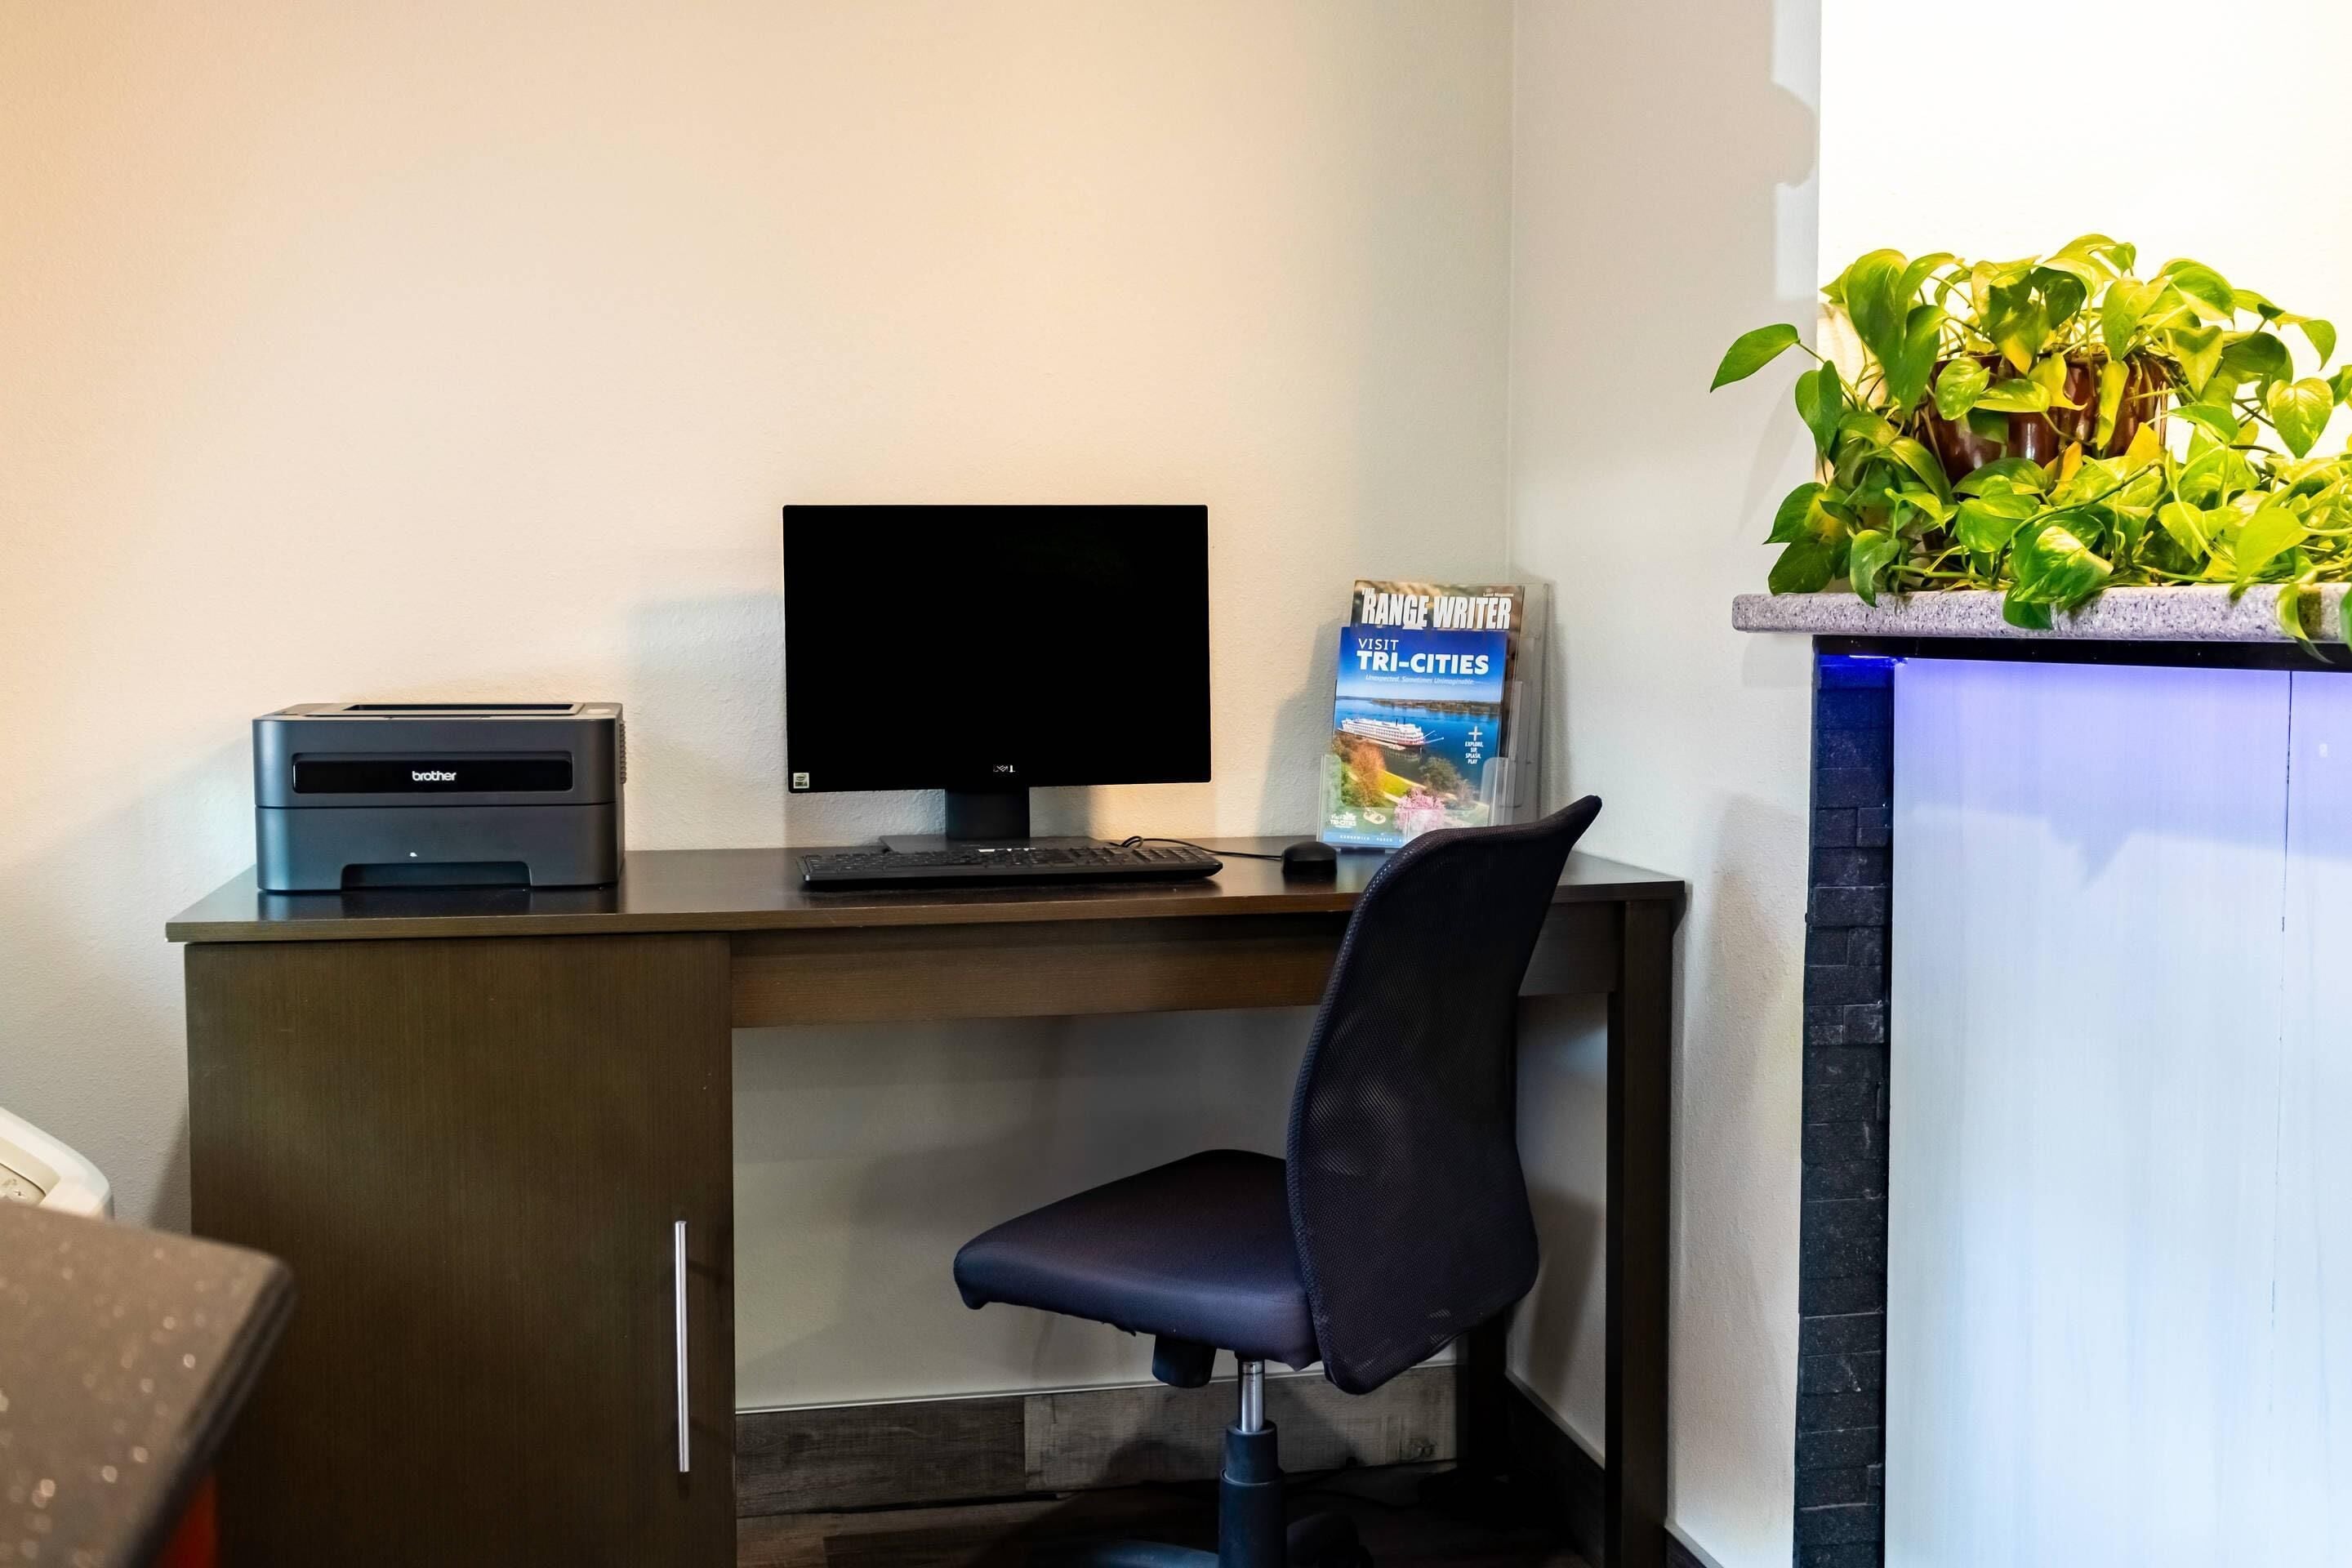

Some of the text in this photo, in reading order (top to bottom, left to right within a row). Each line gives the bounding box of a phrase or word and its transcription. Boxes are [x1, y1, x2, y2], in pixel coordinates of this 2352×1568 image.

[1361, 593, 1512, 630] RANGE WRITER
[1358, 638, 1399, 651] VISIT
[1356, 650, 1489, 675] TRI-CITIES
[412, 770, 457, 782] brother
